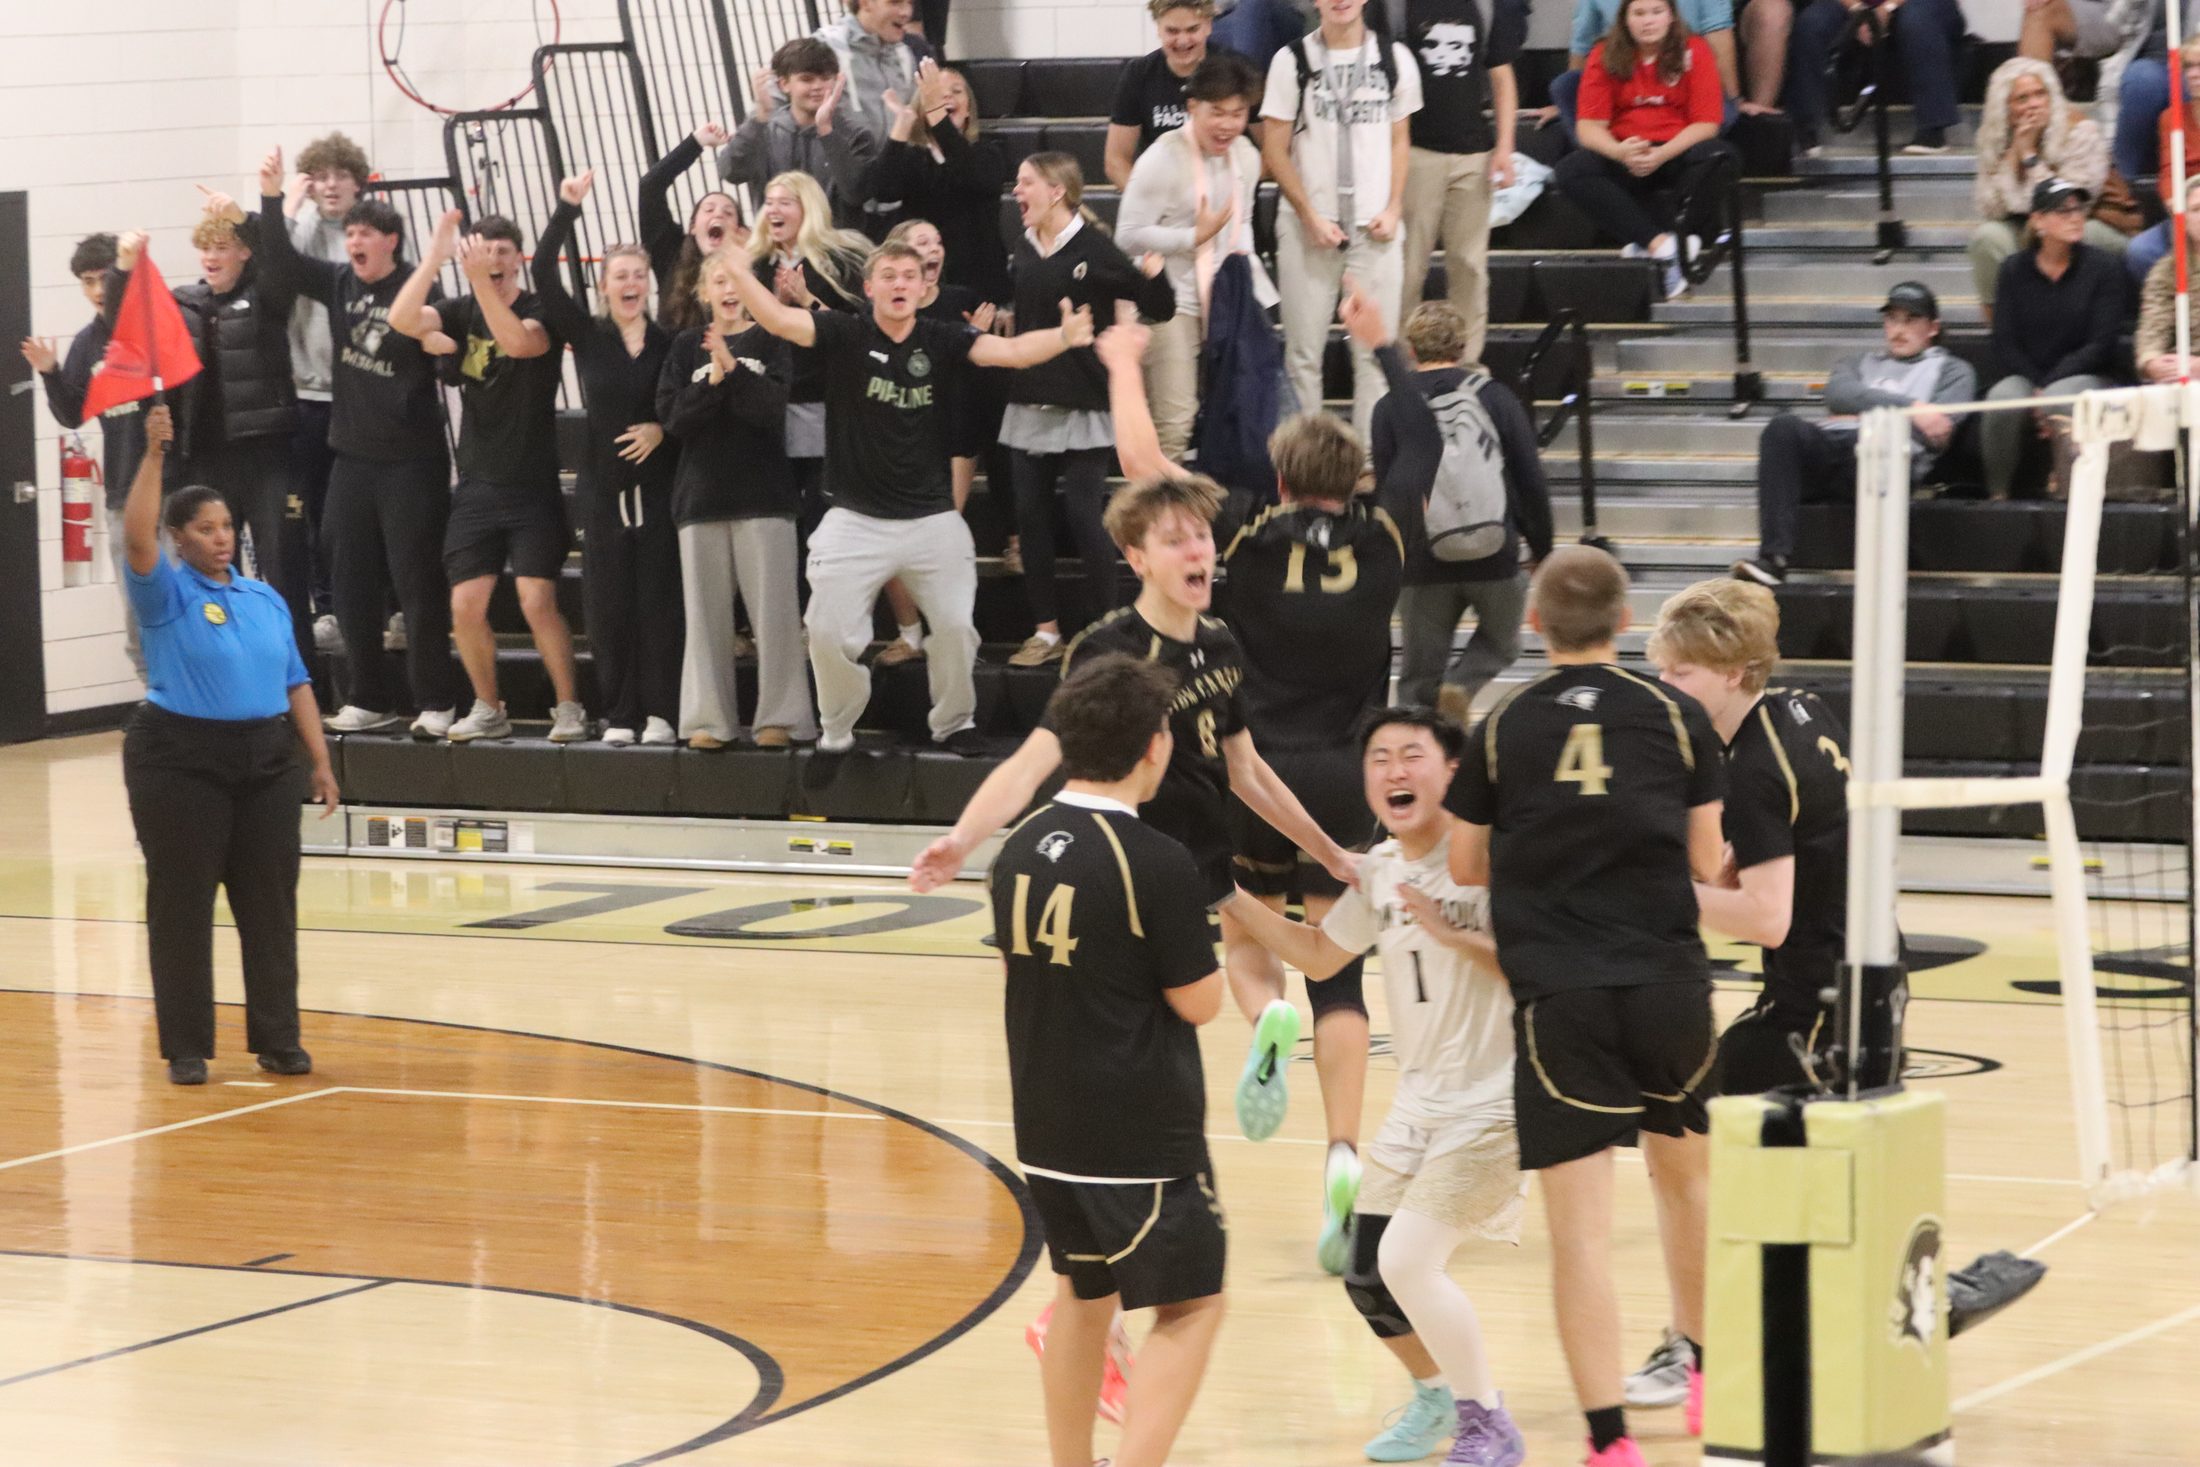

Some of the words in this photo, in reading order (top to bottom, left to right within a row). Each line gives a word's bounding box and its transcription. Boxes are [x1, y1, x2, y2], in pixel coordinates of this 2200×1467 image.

[1553, 723, 1613, 796] 4
[1011, 872, 1080, 967] 14
[1411, 950, 1430, 1002] 1
